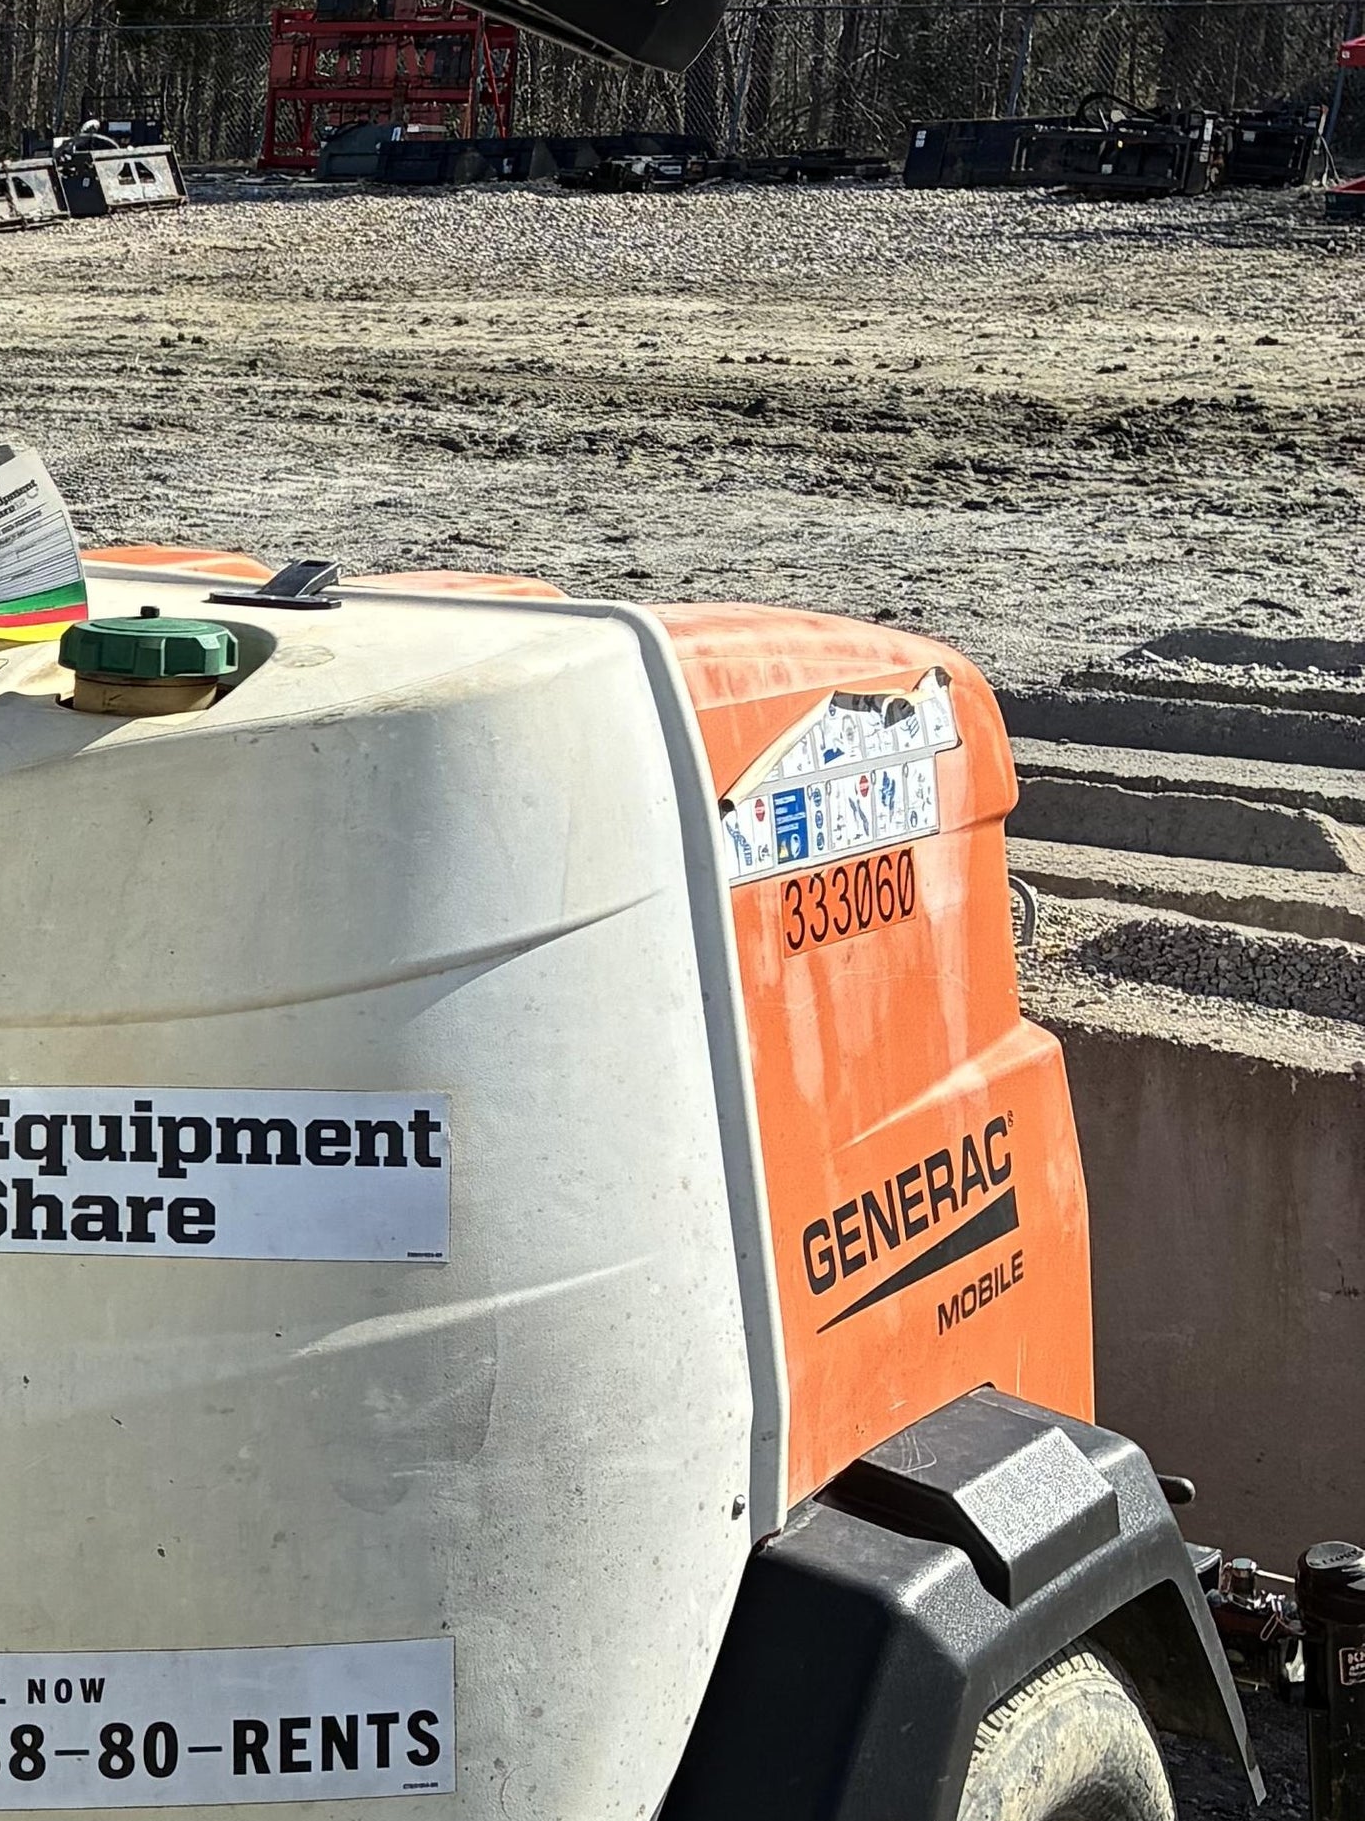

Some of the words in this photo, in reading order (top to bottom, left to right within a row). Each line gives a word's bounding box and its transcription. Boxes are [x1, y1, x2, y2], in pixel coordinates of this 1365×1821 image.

[785, 848, 916, 951] 333060
[937, 1249, 1024, 1336] MOBILE
[27, 1678, 107, 1705] NOW
